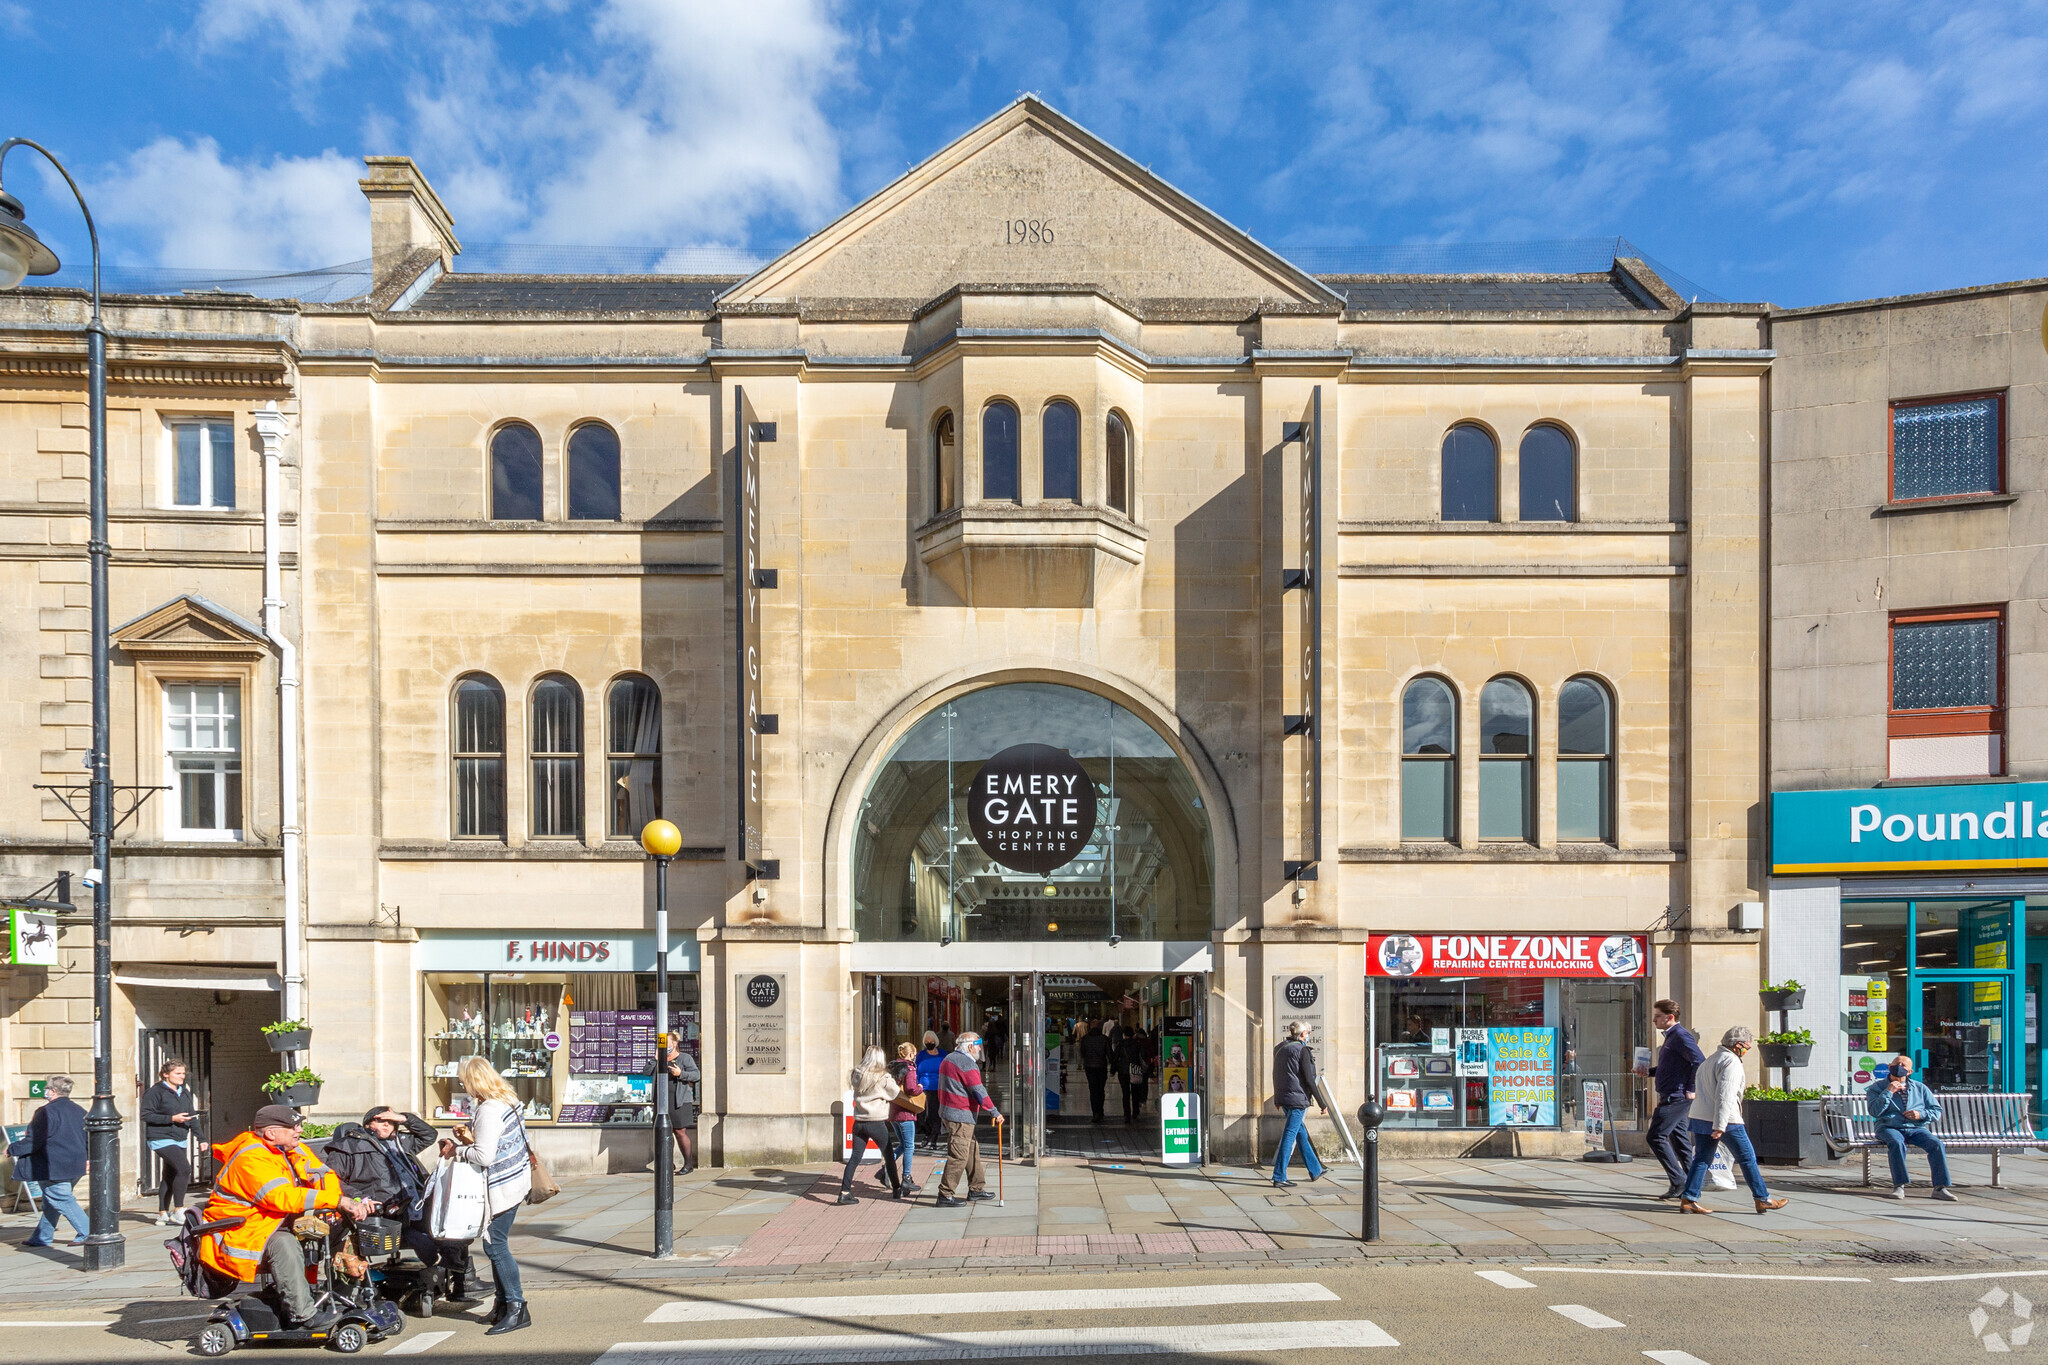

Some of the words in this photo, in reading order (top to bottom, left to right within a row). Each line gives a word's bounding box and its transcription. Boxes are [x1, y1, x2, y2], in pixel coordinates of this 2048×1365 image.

[1006, 219, 1054, 244] 1986
[746, 424, 757, 623] EMERY
[1303, 424, 1311, 624] EMERY
[748, 646, 757, 803] GATE
[1303, 645, 1311, 803] GATE
[986, 774, 1078, 795] EMERY
[984, 798, 1078, 825] GATE
[987, 831, 1078, 839] SHOPPING
[999, 842, 1066, 851] CENTRE
[508, 941, 523, 959] F.
[532, 941, 610, 960] HINDS
[1433, 960, 1485, 969] REPAIRING
[1488, 960, 1527, 969] CENTRE
[1537, 960, 1594, 969] UNLOCKING
[1501, 968, 1525, 976] Laptop
[1526, 968, 1552, 976] Repairs
[748, 1034, 779, 1043] Clintons
[1494, 1032, 1518, 1043] We
[1523, 1032, 1552, 1046] Buy
[1499, 1047, 1532, 1058] Sale
[1537, 1046, 1549, 1058] &
[1495, 1060, 1552, 1071] MOBILE
[1492, 1076, 1555, 1087] PHONES
[1492, 1090, 1555, 1102] REPAIR
[1174, 1137, 1189, 1145] ONLY
